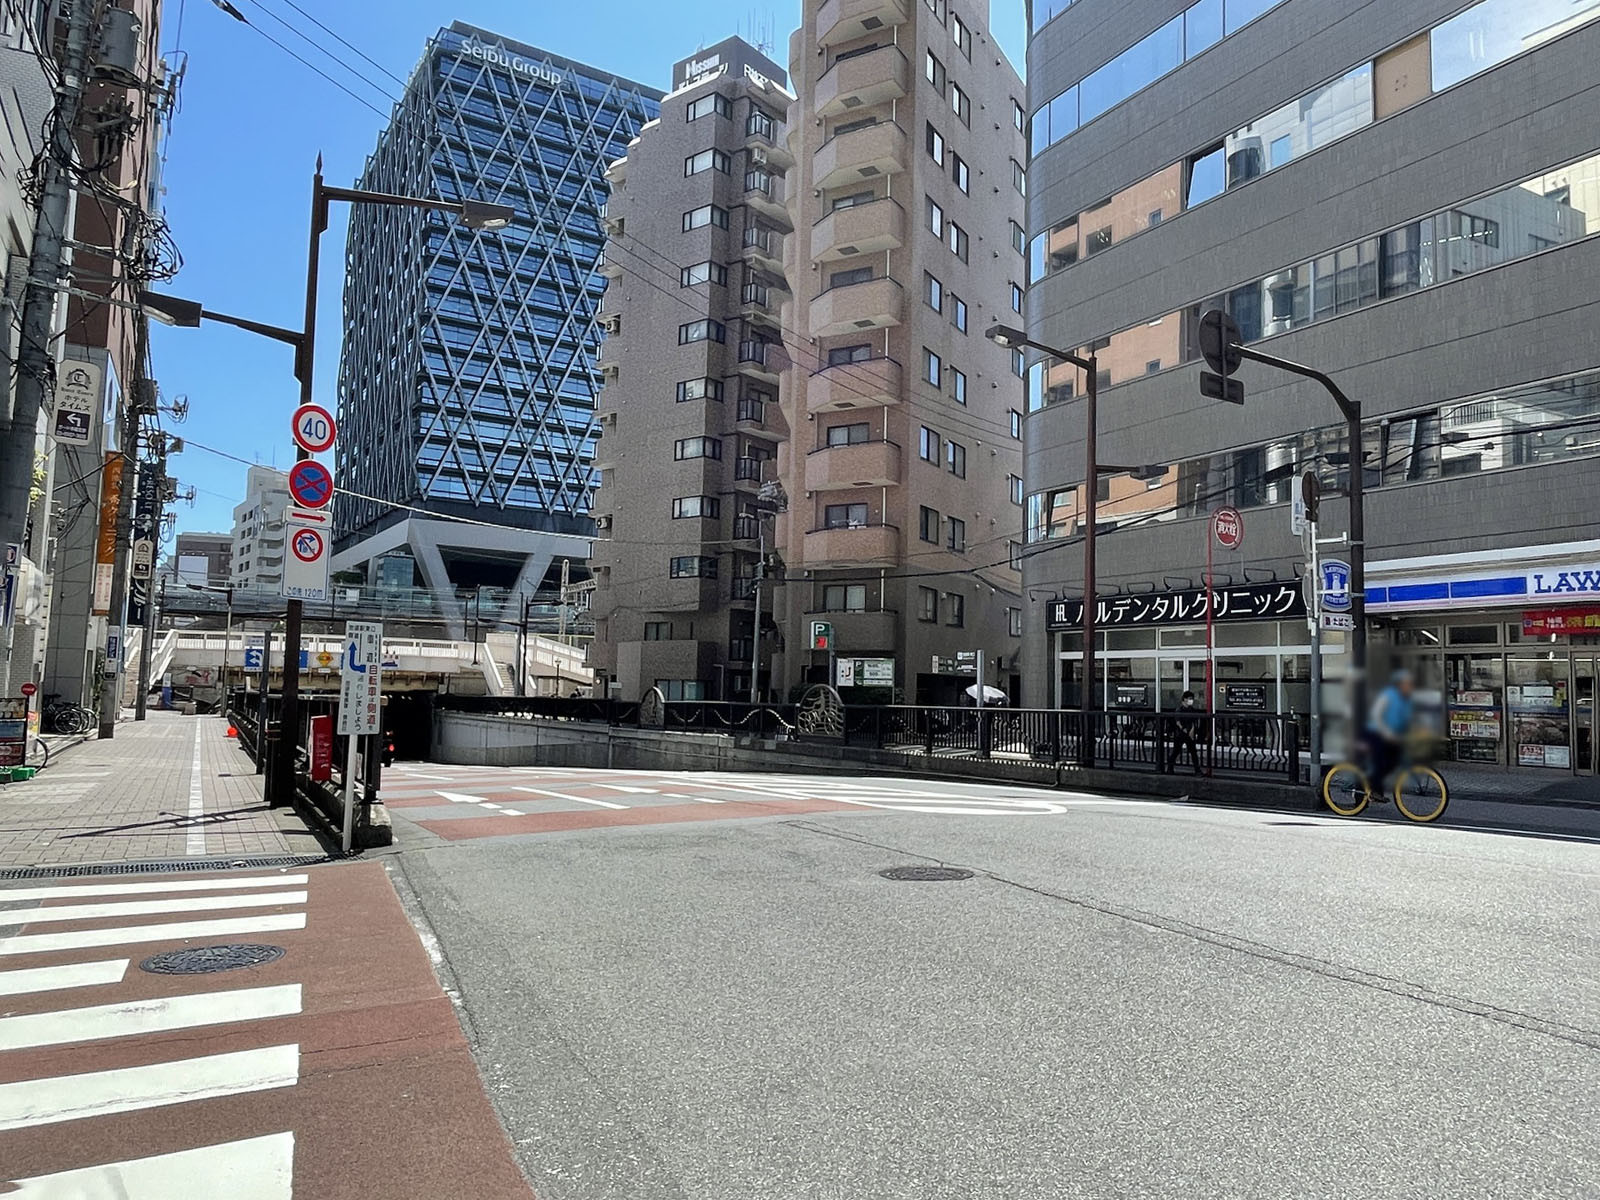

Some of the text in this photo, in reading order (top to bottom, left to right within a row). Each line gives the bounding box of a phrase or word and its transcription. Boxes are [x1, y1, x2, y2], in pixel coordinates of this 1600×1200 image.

[461, 39, 561, 85] Seibu Group
[65, 394, 88, 404] ホテル
[60, 402, 92, 412] タイムズ
[302, 418, 327, 440] 40
[1218, 520, 1237, 536] 消火栓
[1333, 617, 1349, 627] たばこ
[816, 624, 826, 635] P
